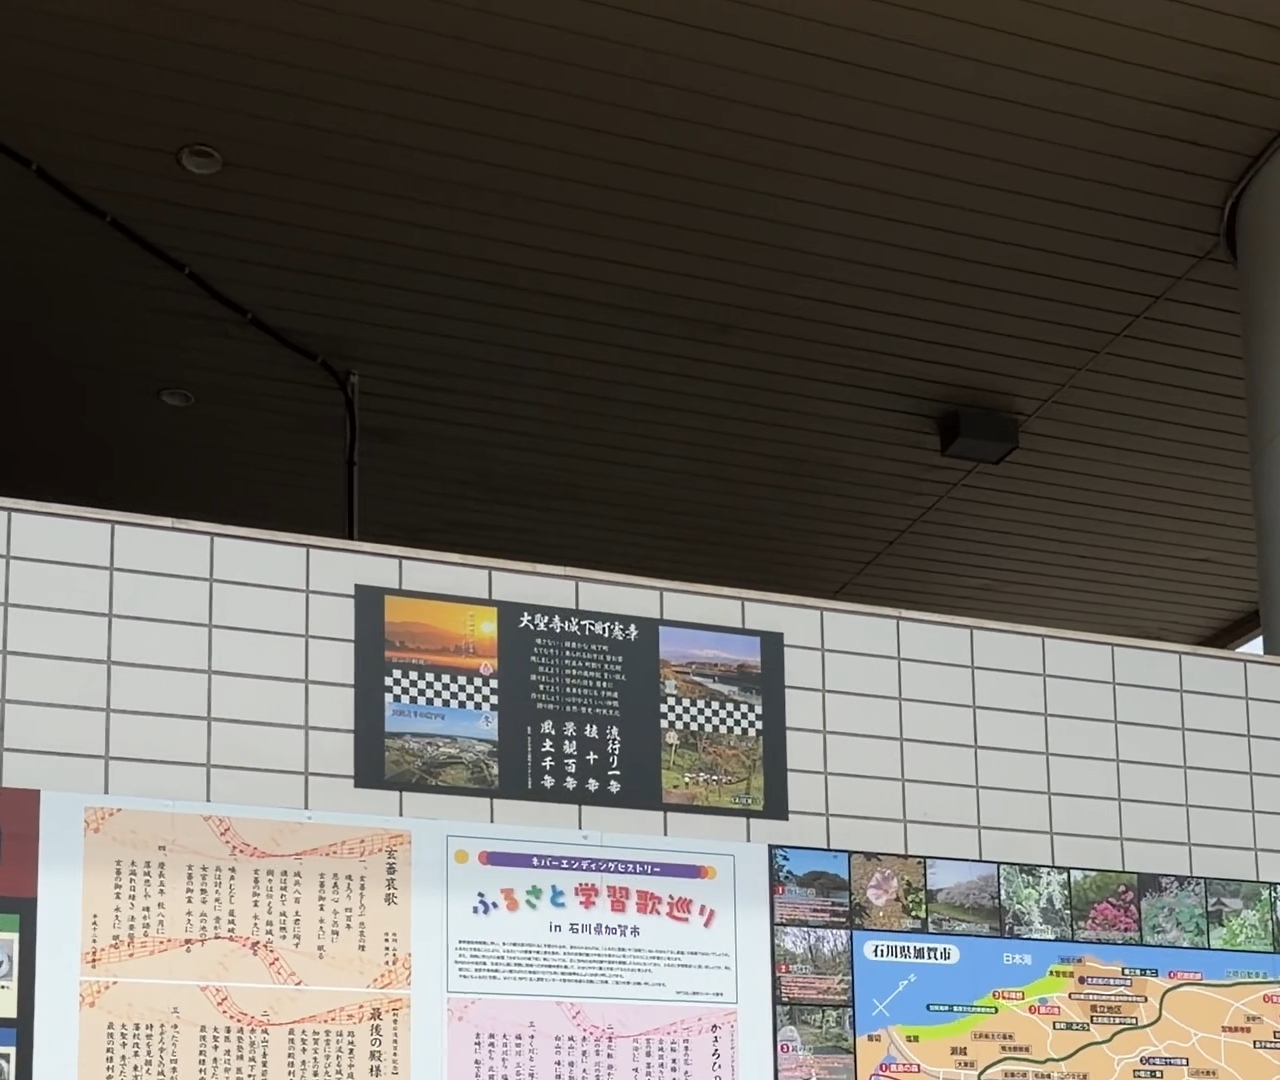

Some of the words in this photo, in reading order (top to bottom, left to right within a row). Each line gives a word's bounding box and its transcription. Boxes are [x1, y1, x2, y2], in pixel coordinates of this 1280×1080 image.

[518, 611, 639, 641] 大聖寺城下町憲章
[540, 719, 556, 789] 風土千年
[562, 721, 577, 791] 景観百年
[532, 856, 661, 875] ネバーエンディングヒストリー
[472, 881, 716, 929] ふるさと学習歌巡り
[549, 921, 562, 933] in
[568, 922, 641, 938] 石川県加賀市
[872, 944, 952, 962] 石川県加賀市
[1003, 952, 1033, 966] 日本海
[368, 1007, 383, 1078] 最後の殿様
